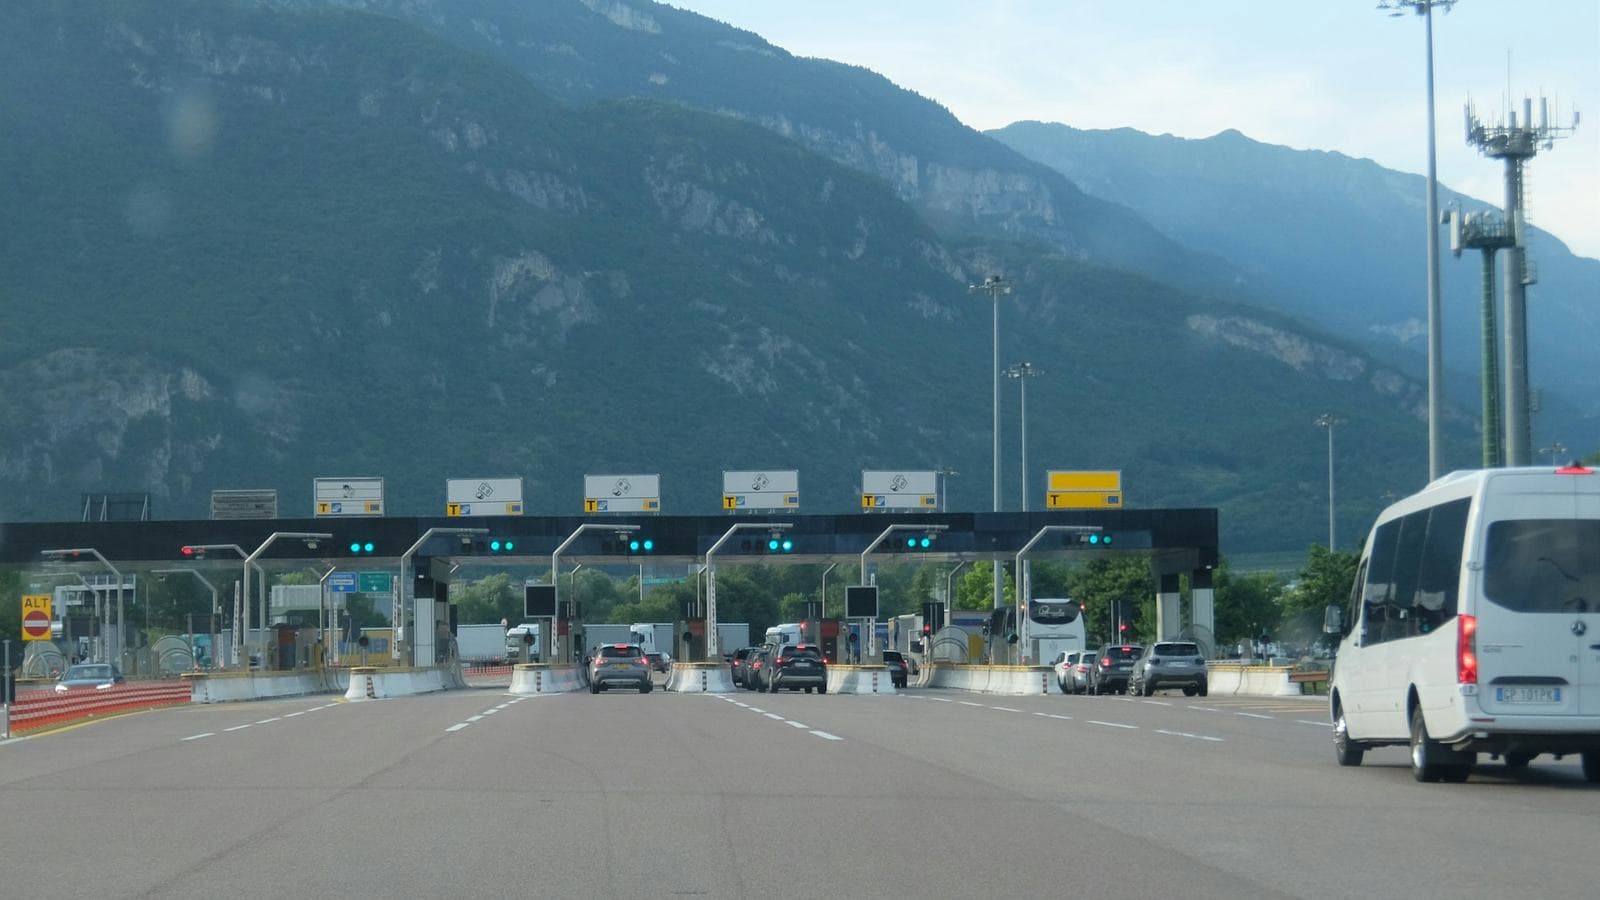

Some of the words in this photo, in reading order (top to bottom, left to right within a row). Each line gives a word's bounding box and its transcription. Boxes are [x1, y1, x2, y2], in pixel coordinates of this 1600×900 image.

[725, 496, 734, 507] T
[863, 495, 873, 506] T
[1050, 494, 1060, 505] T
[319, 503, 328, 513] T
[449, 503, 458, 515] T
[586, 500, 596, 511] T
[24, 597, 49, 608] ALT
